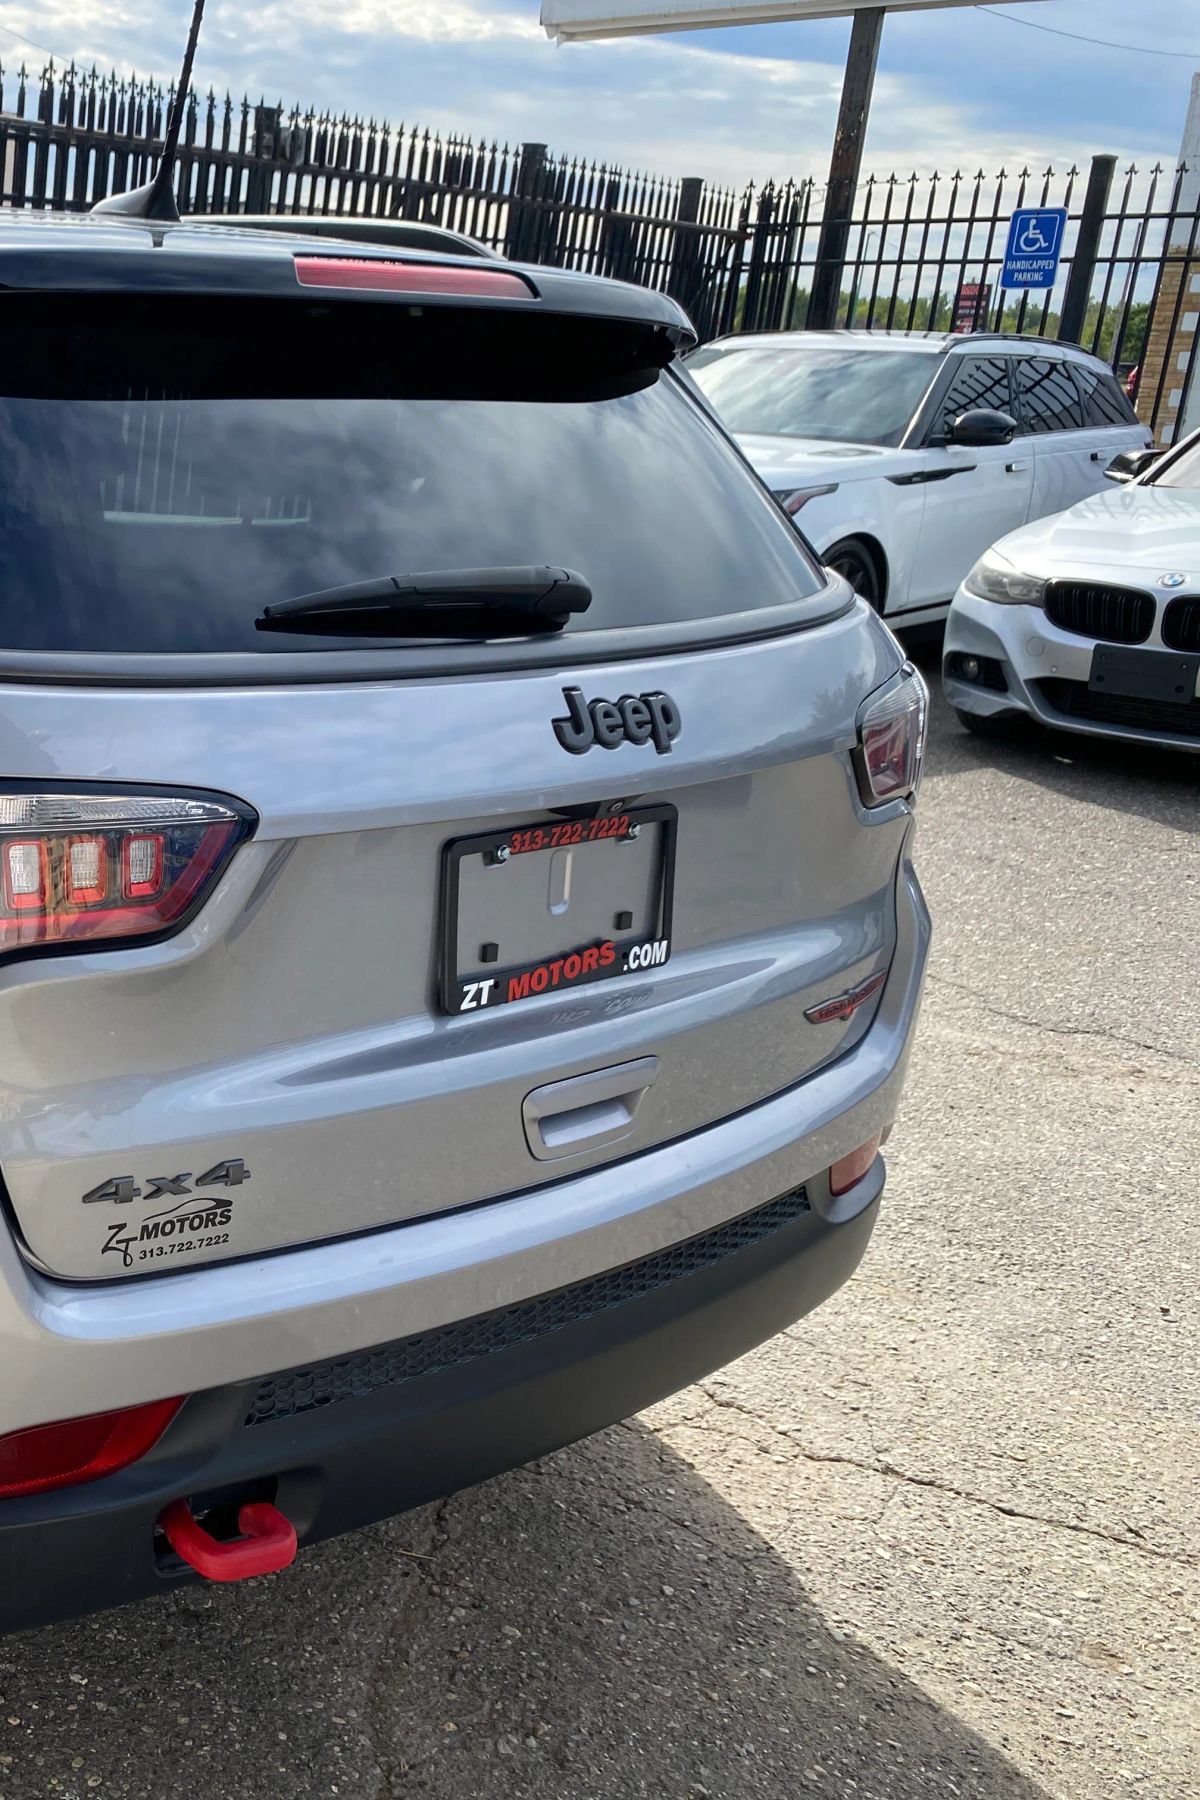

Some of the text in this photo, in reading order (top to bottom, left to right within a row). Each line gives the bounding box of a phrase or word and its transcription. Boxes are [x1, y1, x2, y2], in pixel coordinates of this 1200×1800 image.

[1006, 259, 1055, 270] HANDICAPPED
[1013, 271, 1044, 281] PARKING
[551, 686, 681, 755] Jeep
[509, 815, 630, 854] 313-722-7222
[460, 940, 668, 1011] ZT MOTORS .COM
[139, 1208, 233, 1242] MOTORS
[139, 1233, 230, 1260] 313.722.7222
